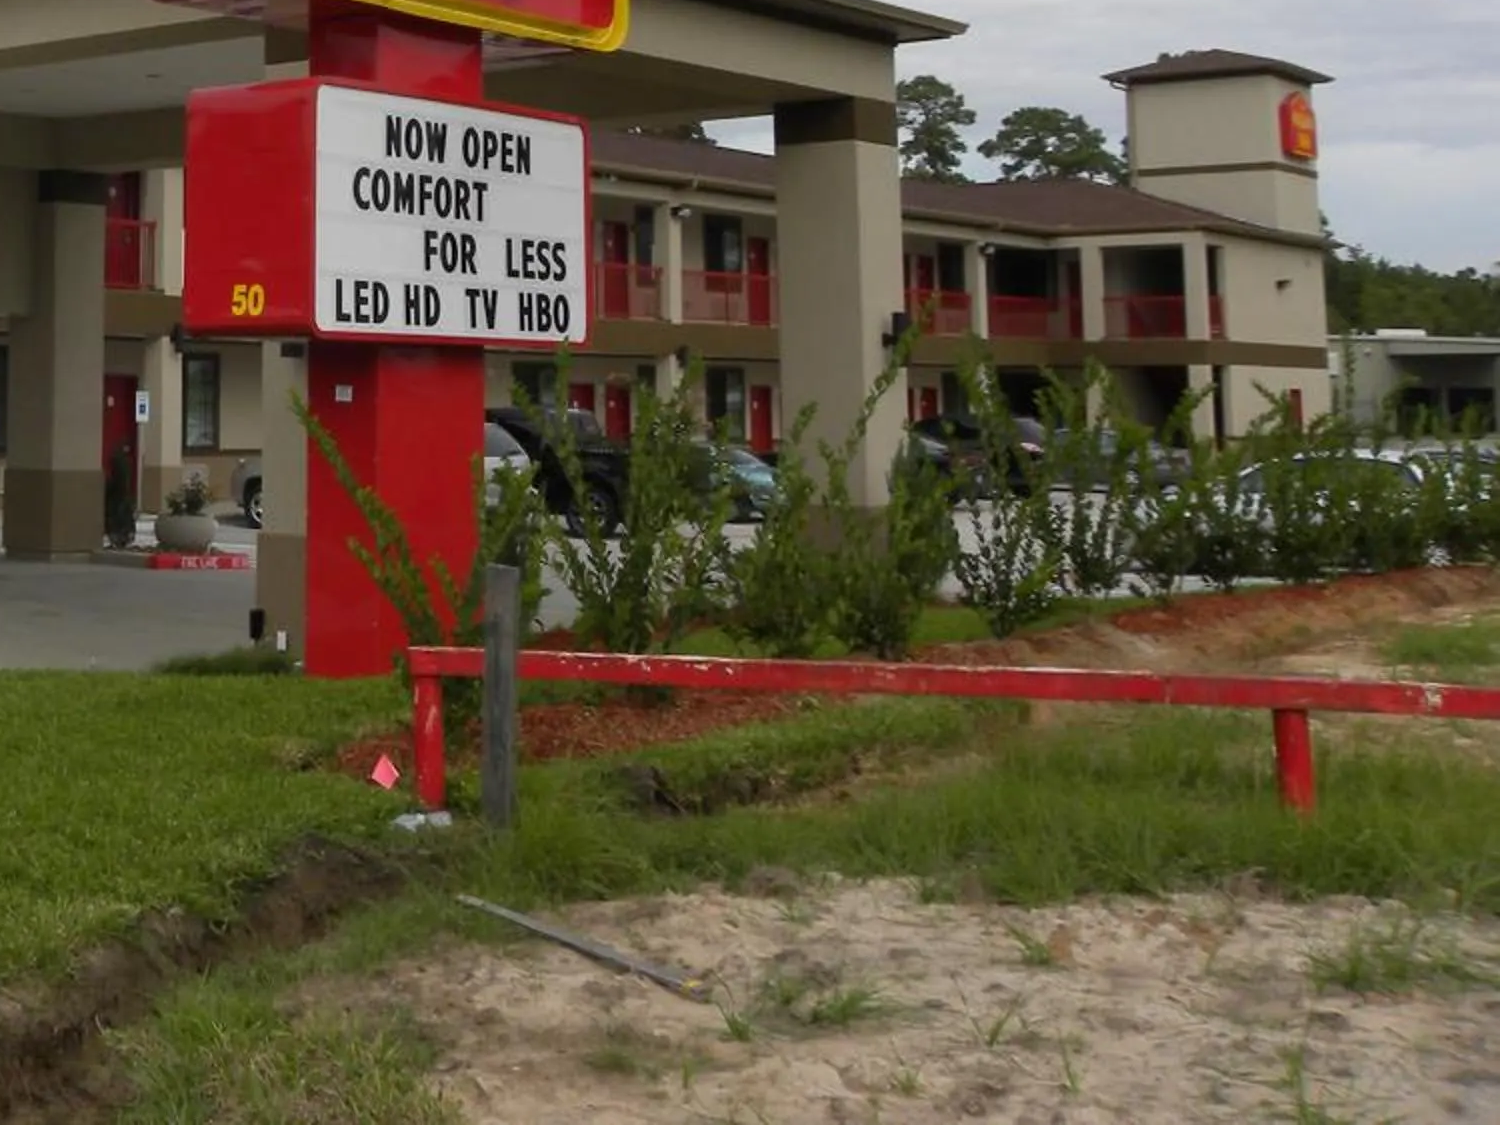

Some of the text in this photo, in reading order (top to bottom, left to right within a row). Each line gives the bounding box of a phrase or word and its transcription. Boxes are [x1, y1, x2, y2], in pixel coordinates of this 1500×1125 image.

[385, 114, 532, 175] NOW OPEN
[352, 166, 489, 222] COMFORT
[423, 230, 568, 282] FOR LESS
[230, 284, 265, 317] 50
[335, 278, 570, 334] LED HD TV HBO
